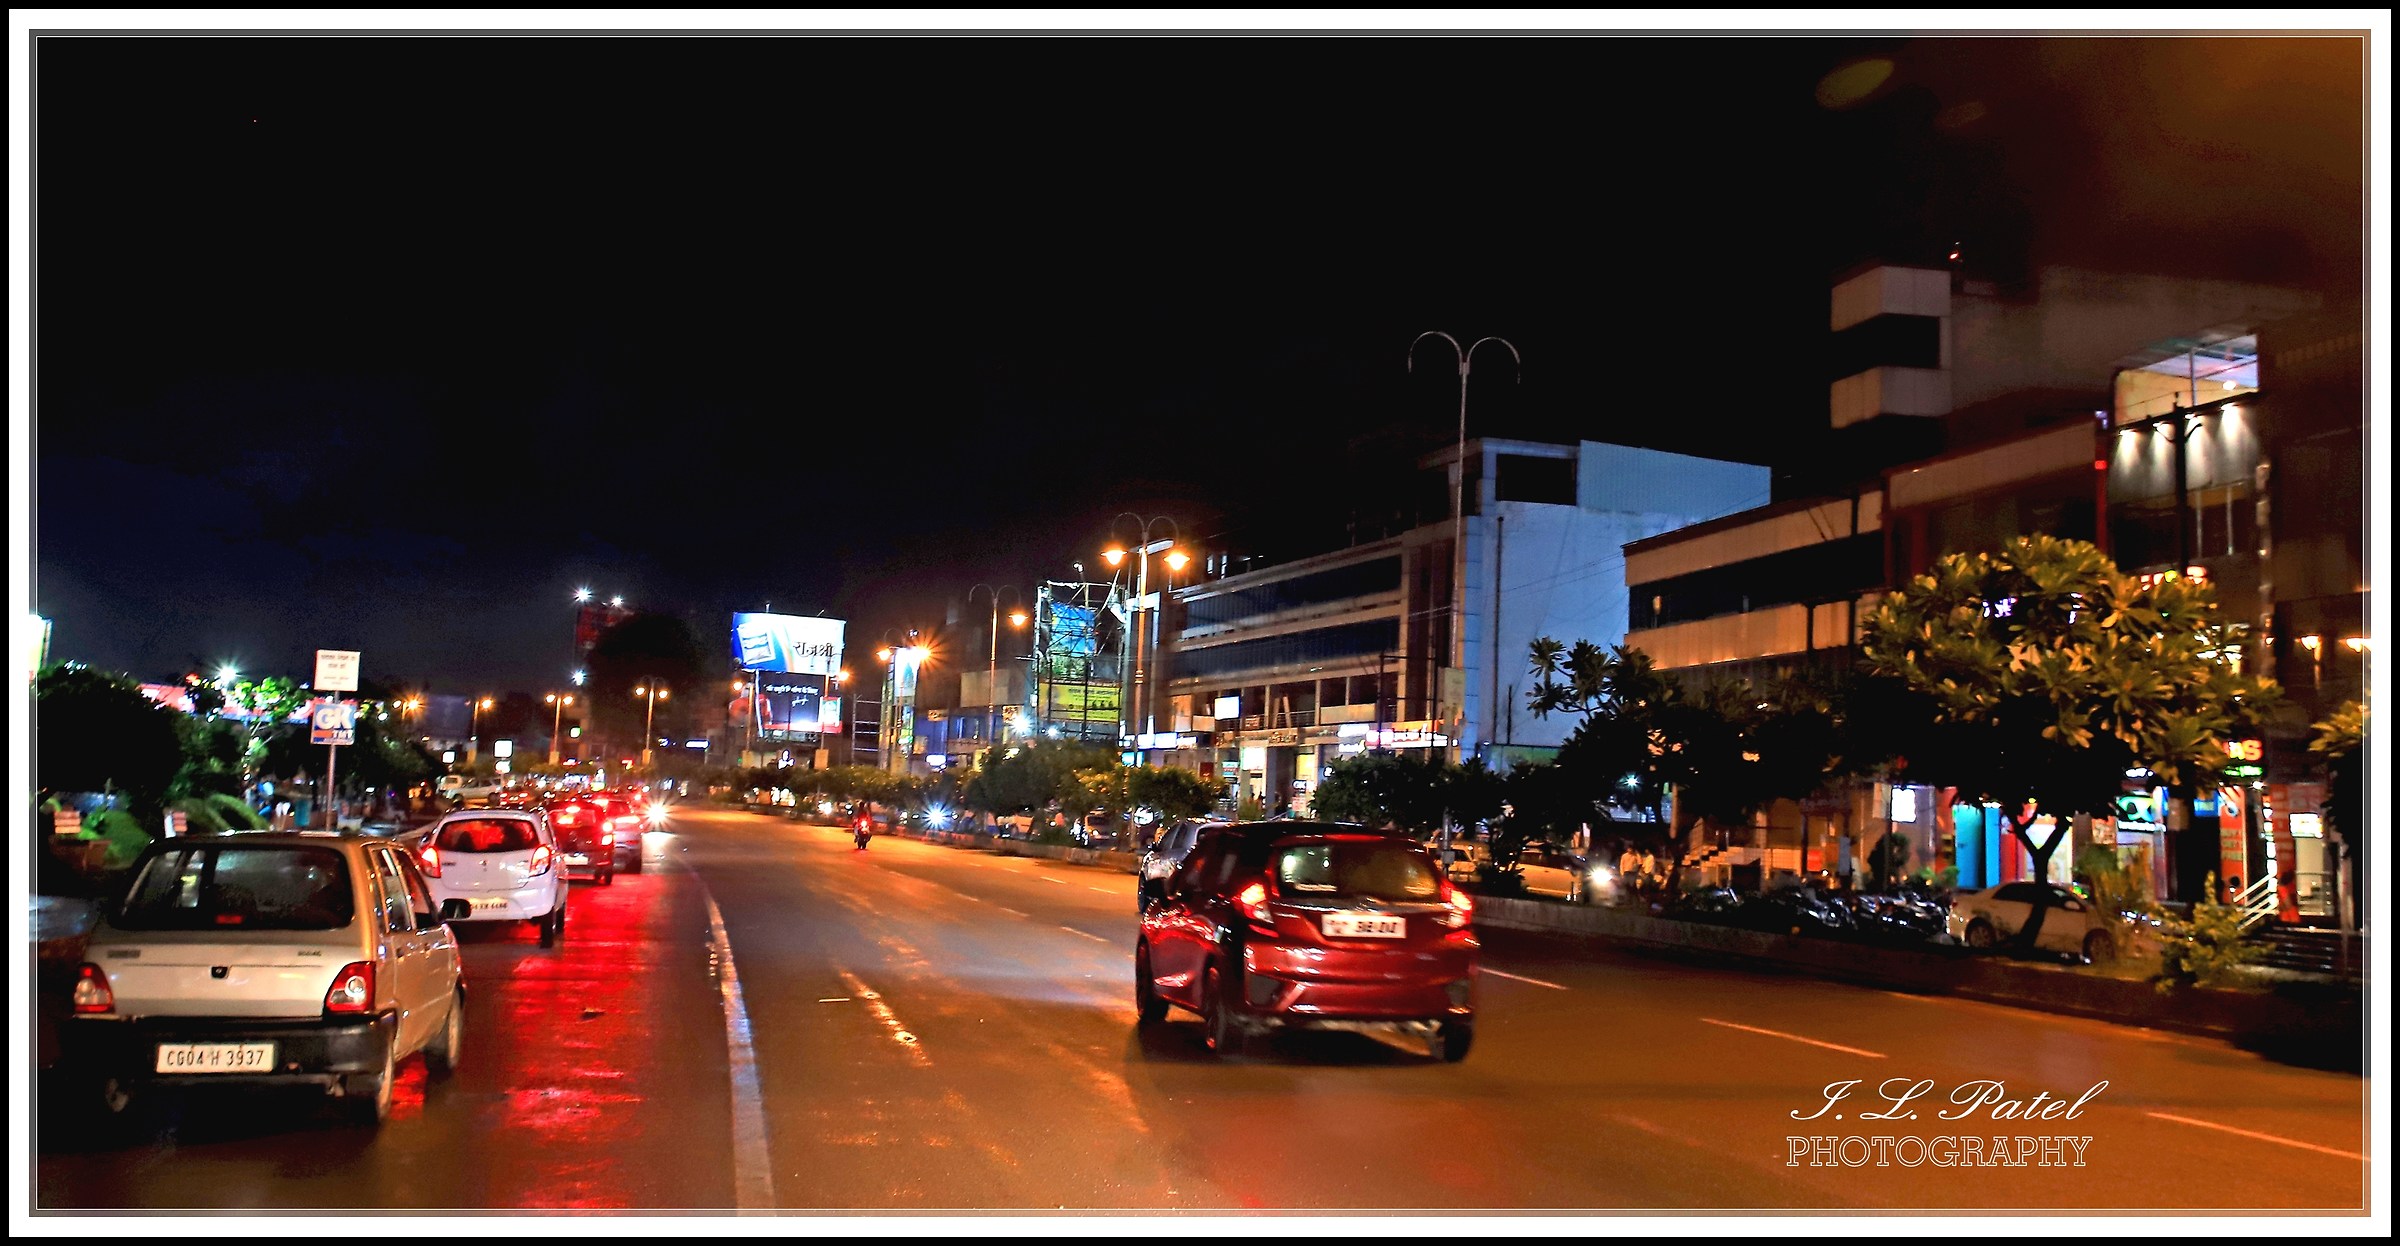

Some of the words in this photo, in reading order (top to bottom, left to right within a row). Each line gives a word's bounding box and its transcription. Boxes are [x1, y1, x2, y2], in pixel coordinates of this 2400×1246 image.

[316, 706, 353, 730] GK
[167, 1050, 204, 1066] CG04
[210, 1050, 220, 1066] H
[226, 1050, 264, 1066] 3937
